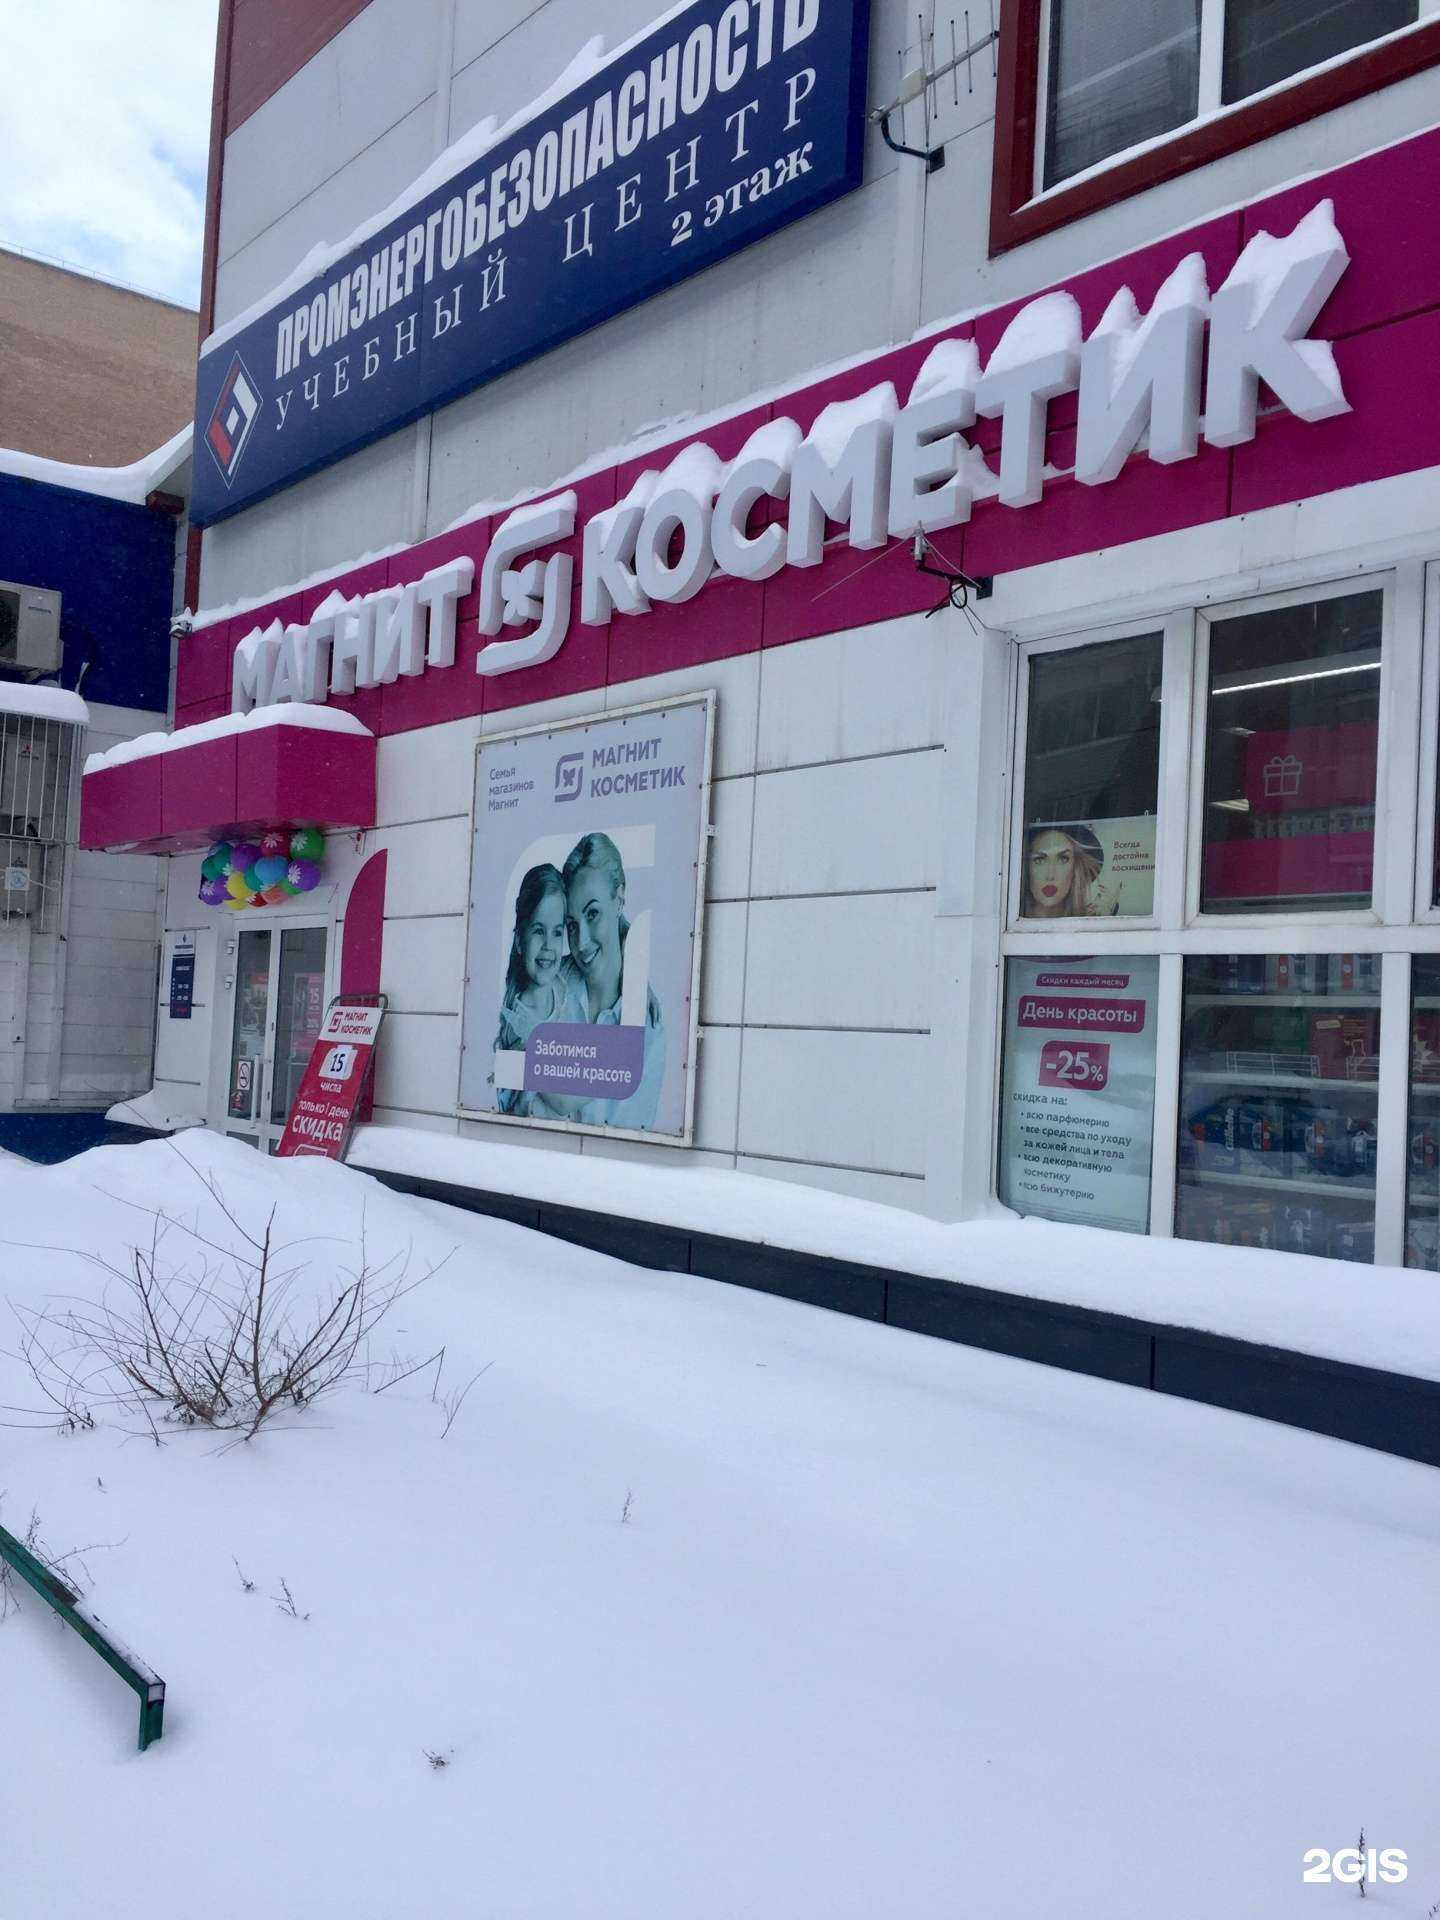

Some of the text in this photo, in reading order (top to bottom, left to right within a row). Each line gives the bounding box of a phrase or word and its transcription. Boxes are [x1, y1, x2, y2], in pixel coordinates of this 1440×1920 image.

[671, 141, 814, 247] 2 этаж
[276, 68, 817, 430] УЧЕБНЫЙ ЦЕНТР
[231, 240, 1353, 714] МАГНИТ КОСМЕТИК
[592, 737, 662, 769] МАГНИТ
[489, 767, 516, 781] Семья
[590, 765, 686, 798] КОСМЕТИК
[488, 780, 535, 797] магазинов
[488, 797, 519, 812] Магнит
[1041, 976, 1069, 985] Скидки
[1070, 976, 1100, 986] каждый
[344, 1011, 369, 1022] МАГНИТ
[1023, 1002, 1137, 1024] День красоты
[535, 1039, 597, 1059] Заботимся
[330, 1053, 346, 1073] 15
[534, 1062, 632, 1084] о вашей красоте
[320, 1081, 342, 1094] числа
[1042, 1127, 1086, 1140] средства
[1100, 1134, 1132, 1147] уходу
[1036, 1141, 1068, 1152] кожей
[1069, 1145, 1091, 1156] лица
[1102, 1150, 1125, 1160] тела
[1041, 1156, 1112, 1174] декоративную
[1040, 1183, 1095, 1200] бижутерию
